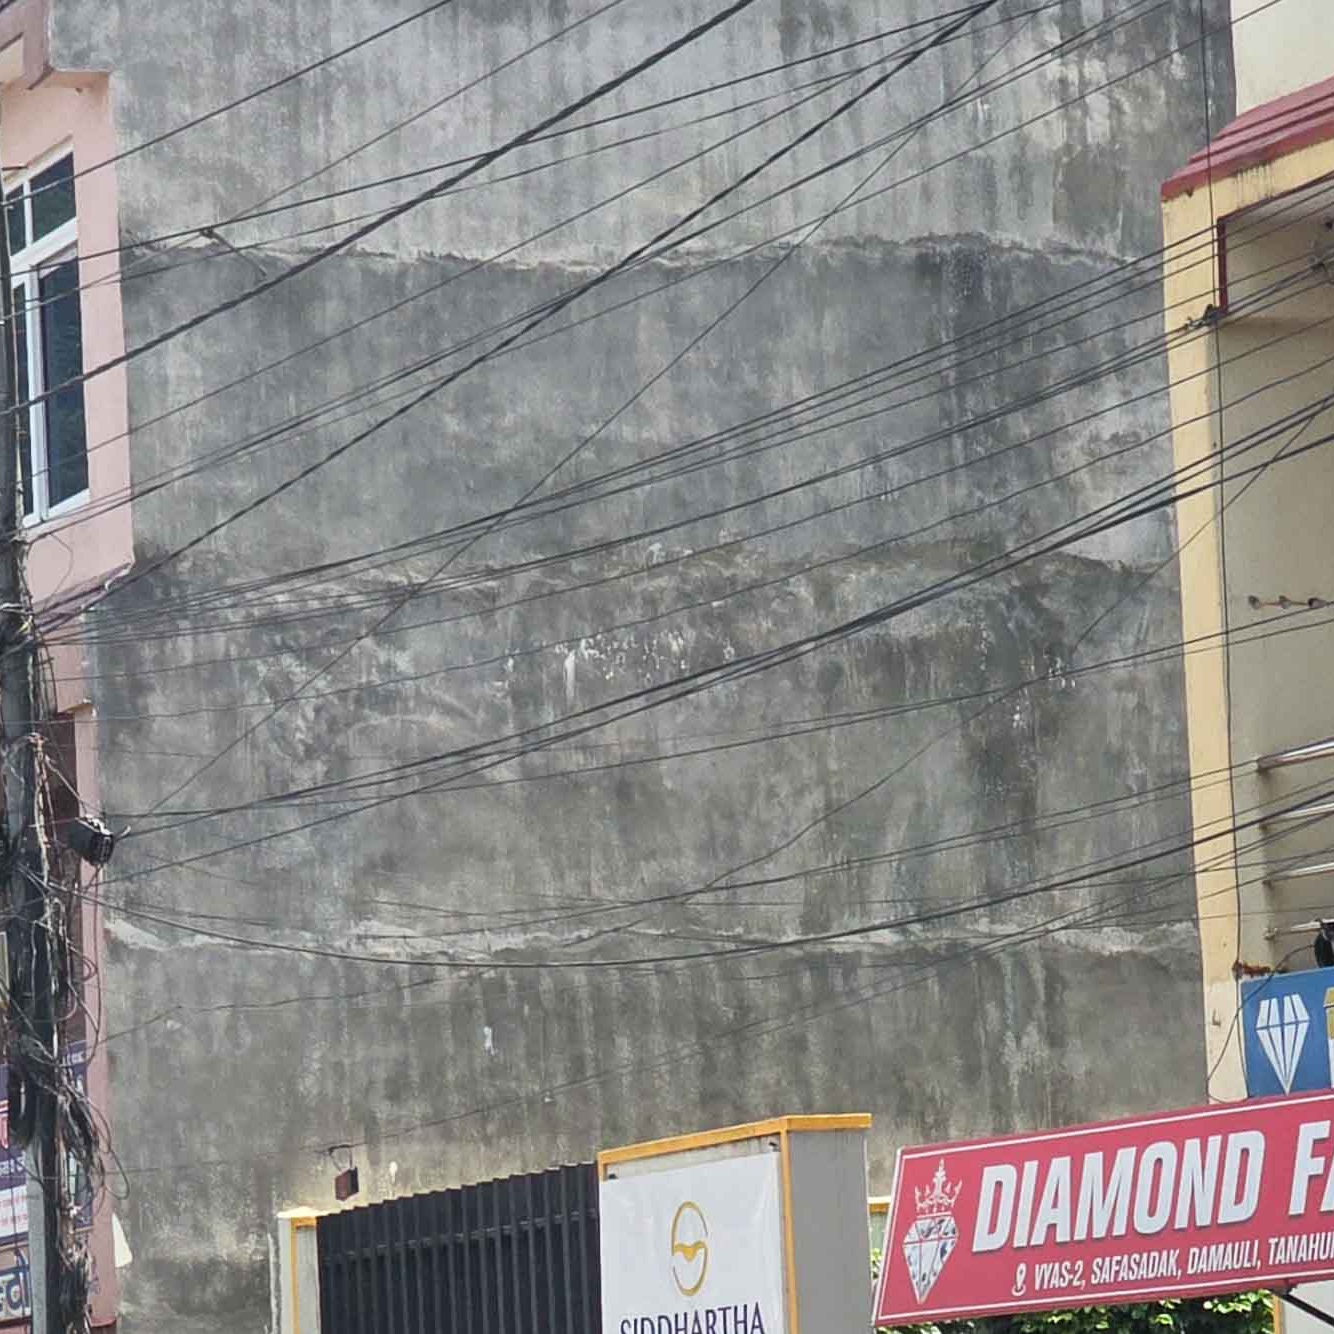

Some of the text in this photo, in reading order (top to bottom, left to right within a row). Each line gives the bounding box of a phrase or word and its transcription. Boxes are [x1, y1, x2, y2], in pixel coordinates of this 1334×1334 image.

[972, 1129, 1266, 1252] DIAMOND
[1034, 1257, 1085, 1291] VYAS-2,
[1090, 1246, 1182, 1286] SAFASADAK,
[1186, 1238, 1262, 1275] DAMAULI,
